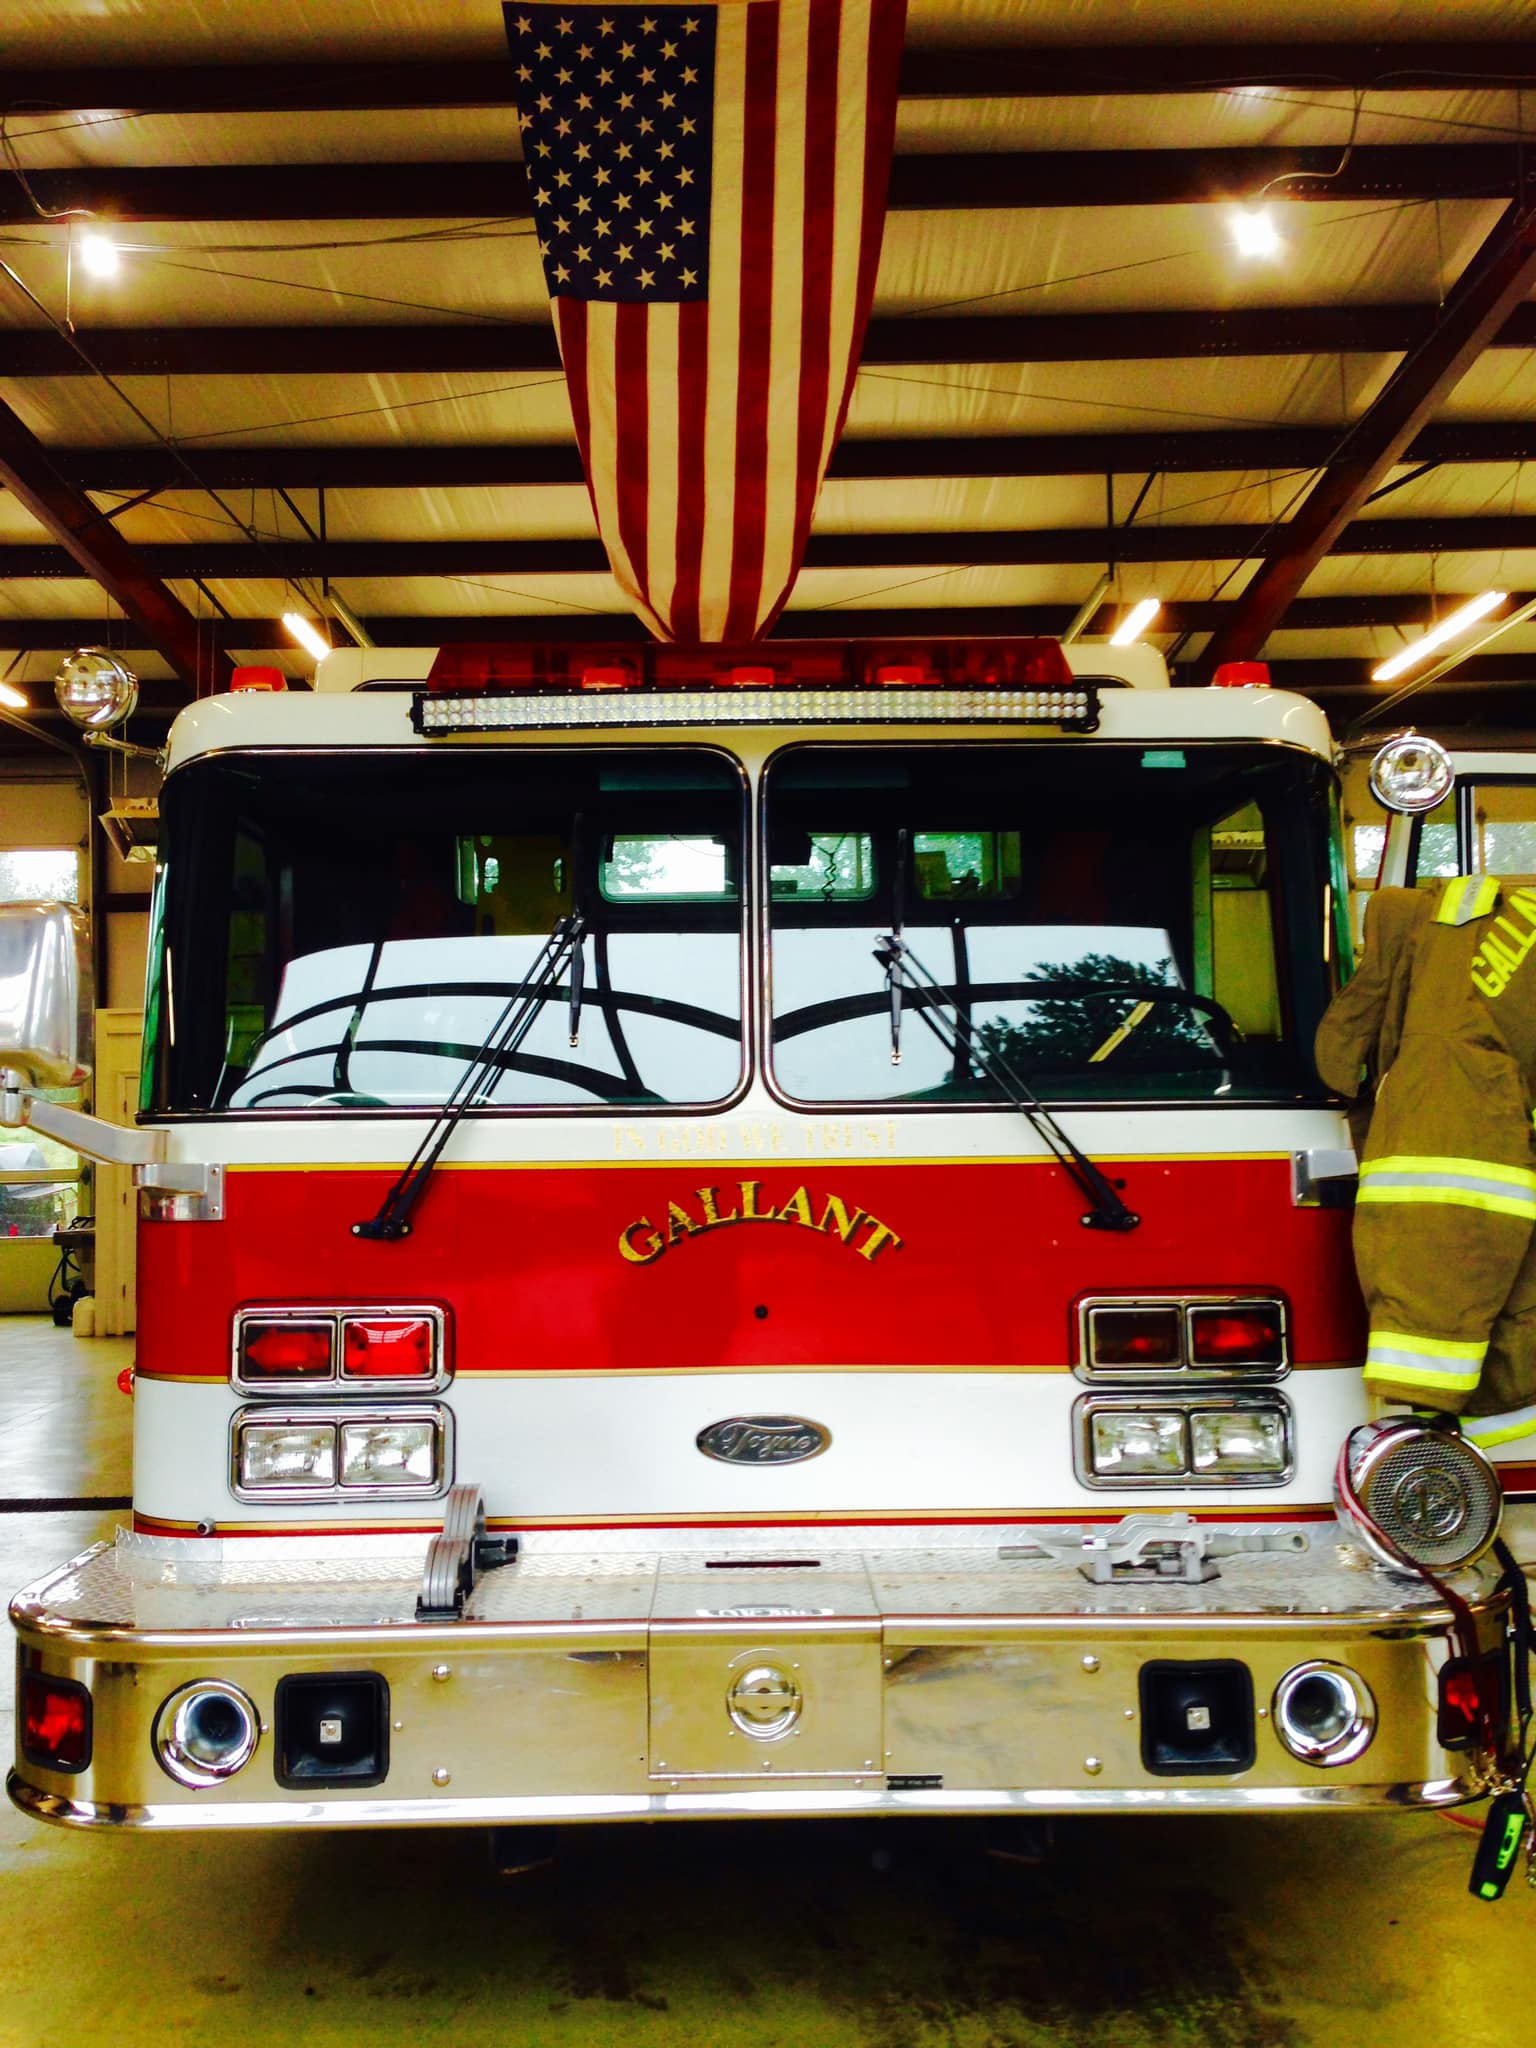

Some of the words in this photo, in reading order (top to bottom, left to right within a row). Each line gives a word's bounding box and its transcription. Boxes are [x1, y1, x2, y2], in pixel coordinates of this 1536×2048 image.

[613, 1124, 646, 1153] IN
[657, 1123, 727, 1153] GOD
[739, 1121, 790, 1152] WE
[798, 1119, 899, 1152] TRUST
[618, 1180, 903, 1265] GALLANT
